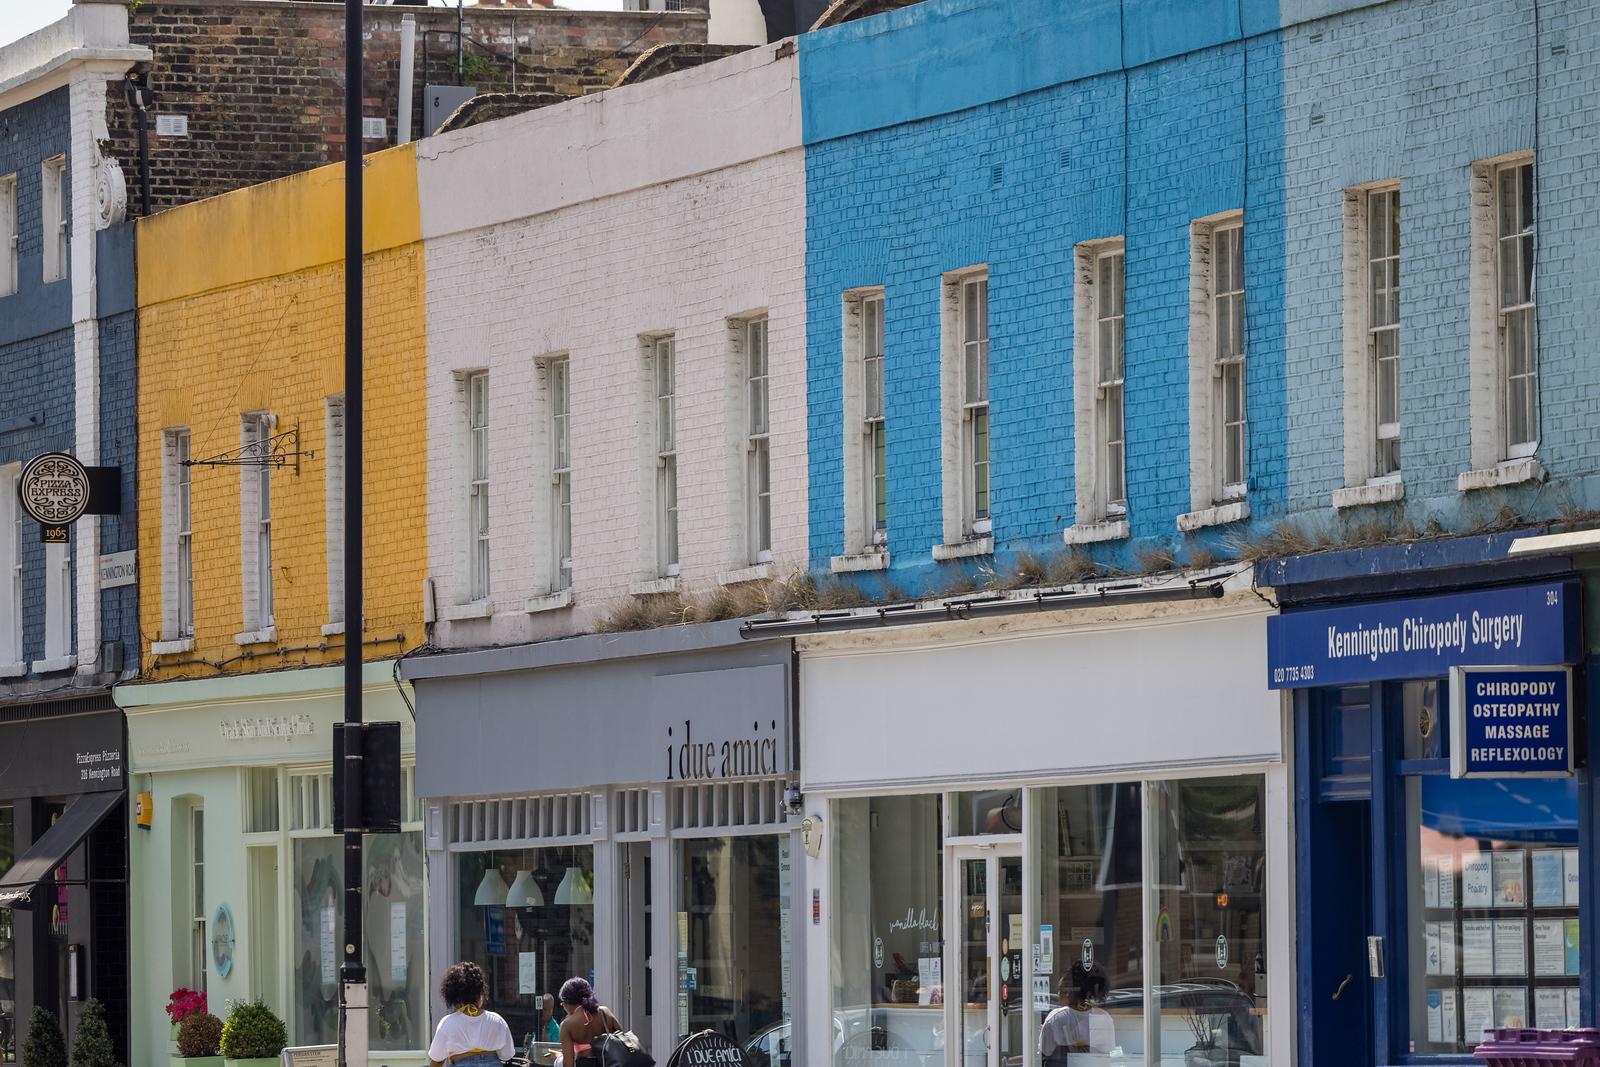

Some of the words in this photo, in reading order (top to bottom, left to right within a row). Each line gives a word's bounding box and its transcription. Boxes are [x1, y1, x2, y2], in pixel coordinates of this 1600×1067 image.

[40, 480, 72, 488] PIZZA
[31, 488, 81, 497] EXPRESS
[46, 527, 67, 539] 1965
[1546, 591, 1558, 606] 304
[1328, 621, 1399, 662] Kennington
[1403, 613, 1467, 655] Chiropody
[1472, 610, 1523, 650] Surgery
[1274, 668, 1284, 683] 020
[1286, 666, 1299, 682] 7735
[1477, 682, 1556, 696] CHIROPODY
[1473, 703, 1560, 717] OSTEOPATHY
[1485, 725, 1549, 739] MASSAGE
[667, 726, 673, 780] i
[679, 719, 716, 780] due
[721, 719, 777, 778] amici
[1471, 747, 1564, 761] REFLEXOLOGY
[694, 1048, 716, 1064] DUE
[716, 1047, 742, 1063] AMICI
